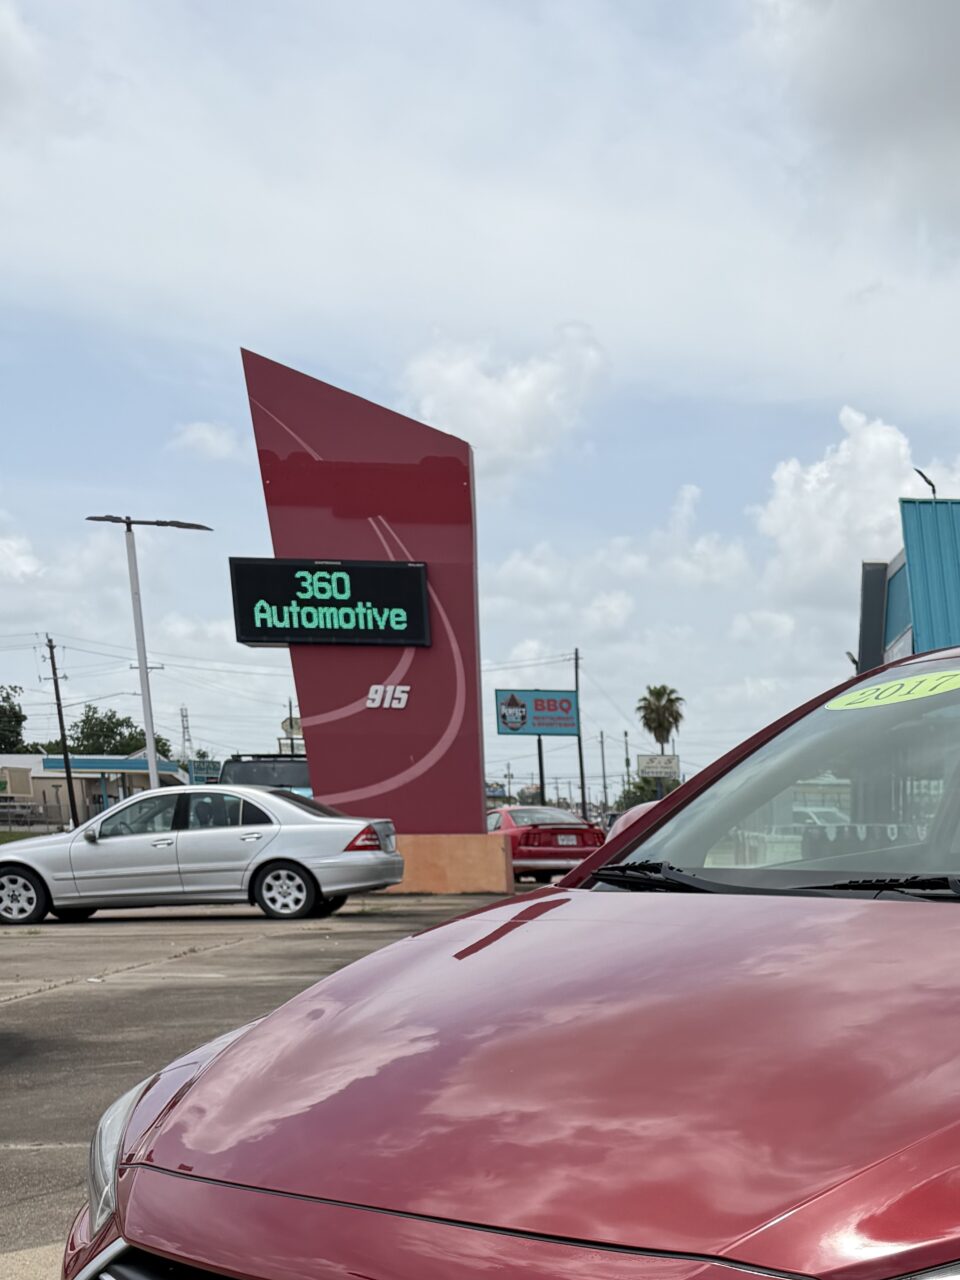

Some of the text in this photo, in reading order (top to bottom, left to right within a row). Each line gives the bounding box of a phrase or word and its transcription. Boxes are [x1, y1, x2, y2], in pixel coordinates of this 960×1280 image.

[295, 571, 351, 600] 360
[253, 599, 408, 630] Automotive
[366, 684, 411, 709] 915
[845, 673, 960, 706] 2017
[534, 699, 572, 714] BBQ
